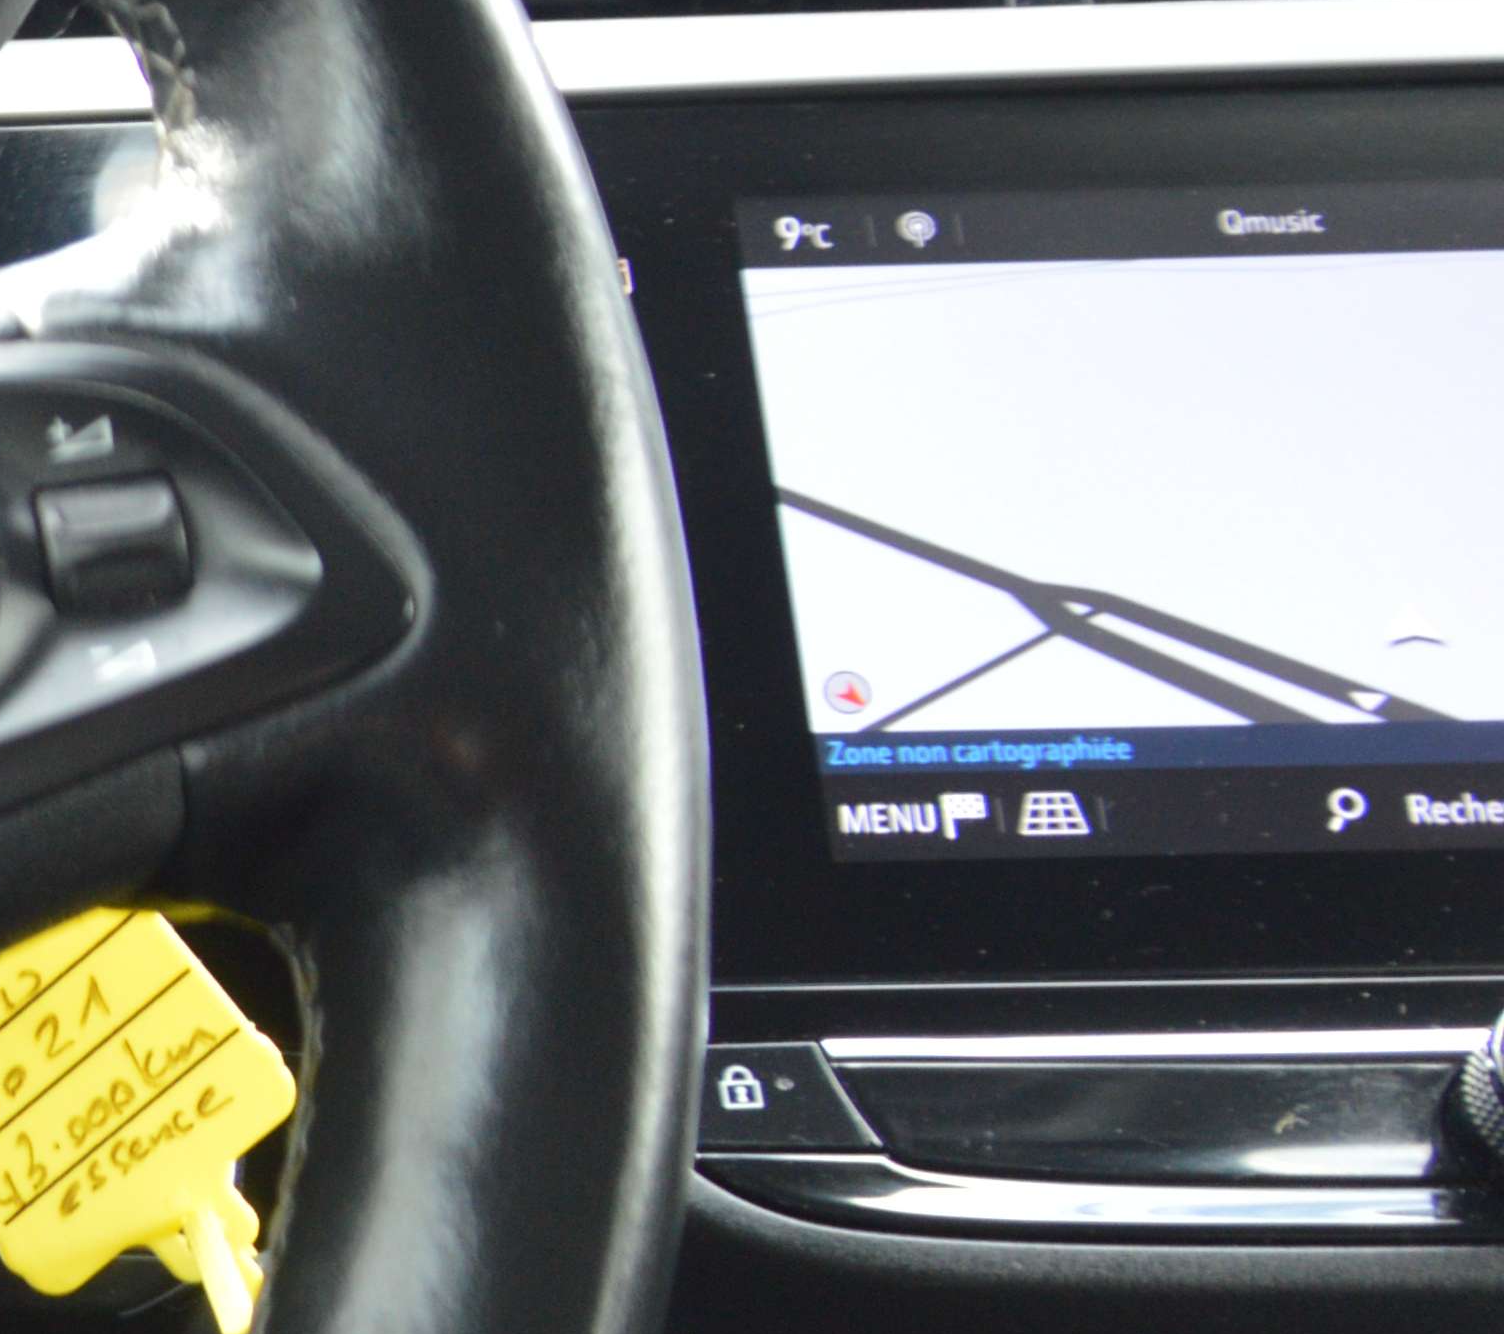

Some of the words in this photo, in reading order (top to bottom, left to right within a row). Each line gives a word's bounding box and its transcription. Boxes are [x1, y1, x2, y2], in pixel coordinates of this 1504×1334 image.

[1217, 209, 1326, 236] Qmusic
[826, 740, 892, 766] Zone
[898, 744, 948, 764] non
[952, 736, 1132, 769] cartographiée
[838, 802, 936, 834] MENU
